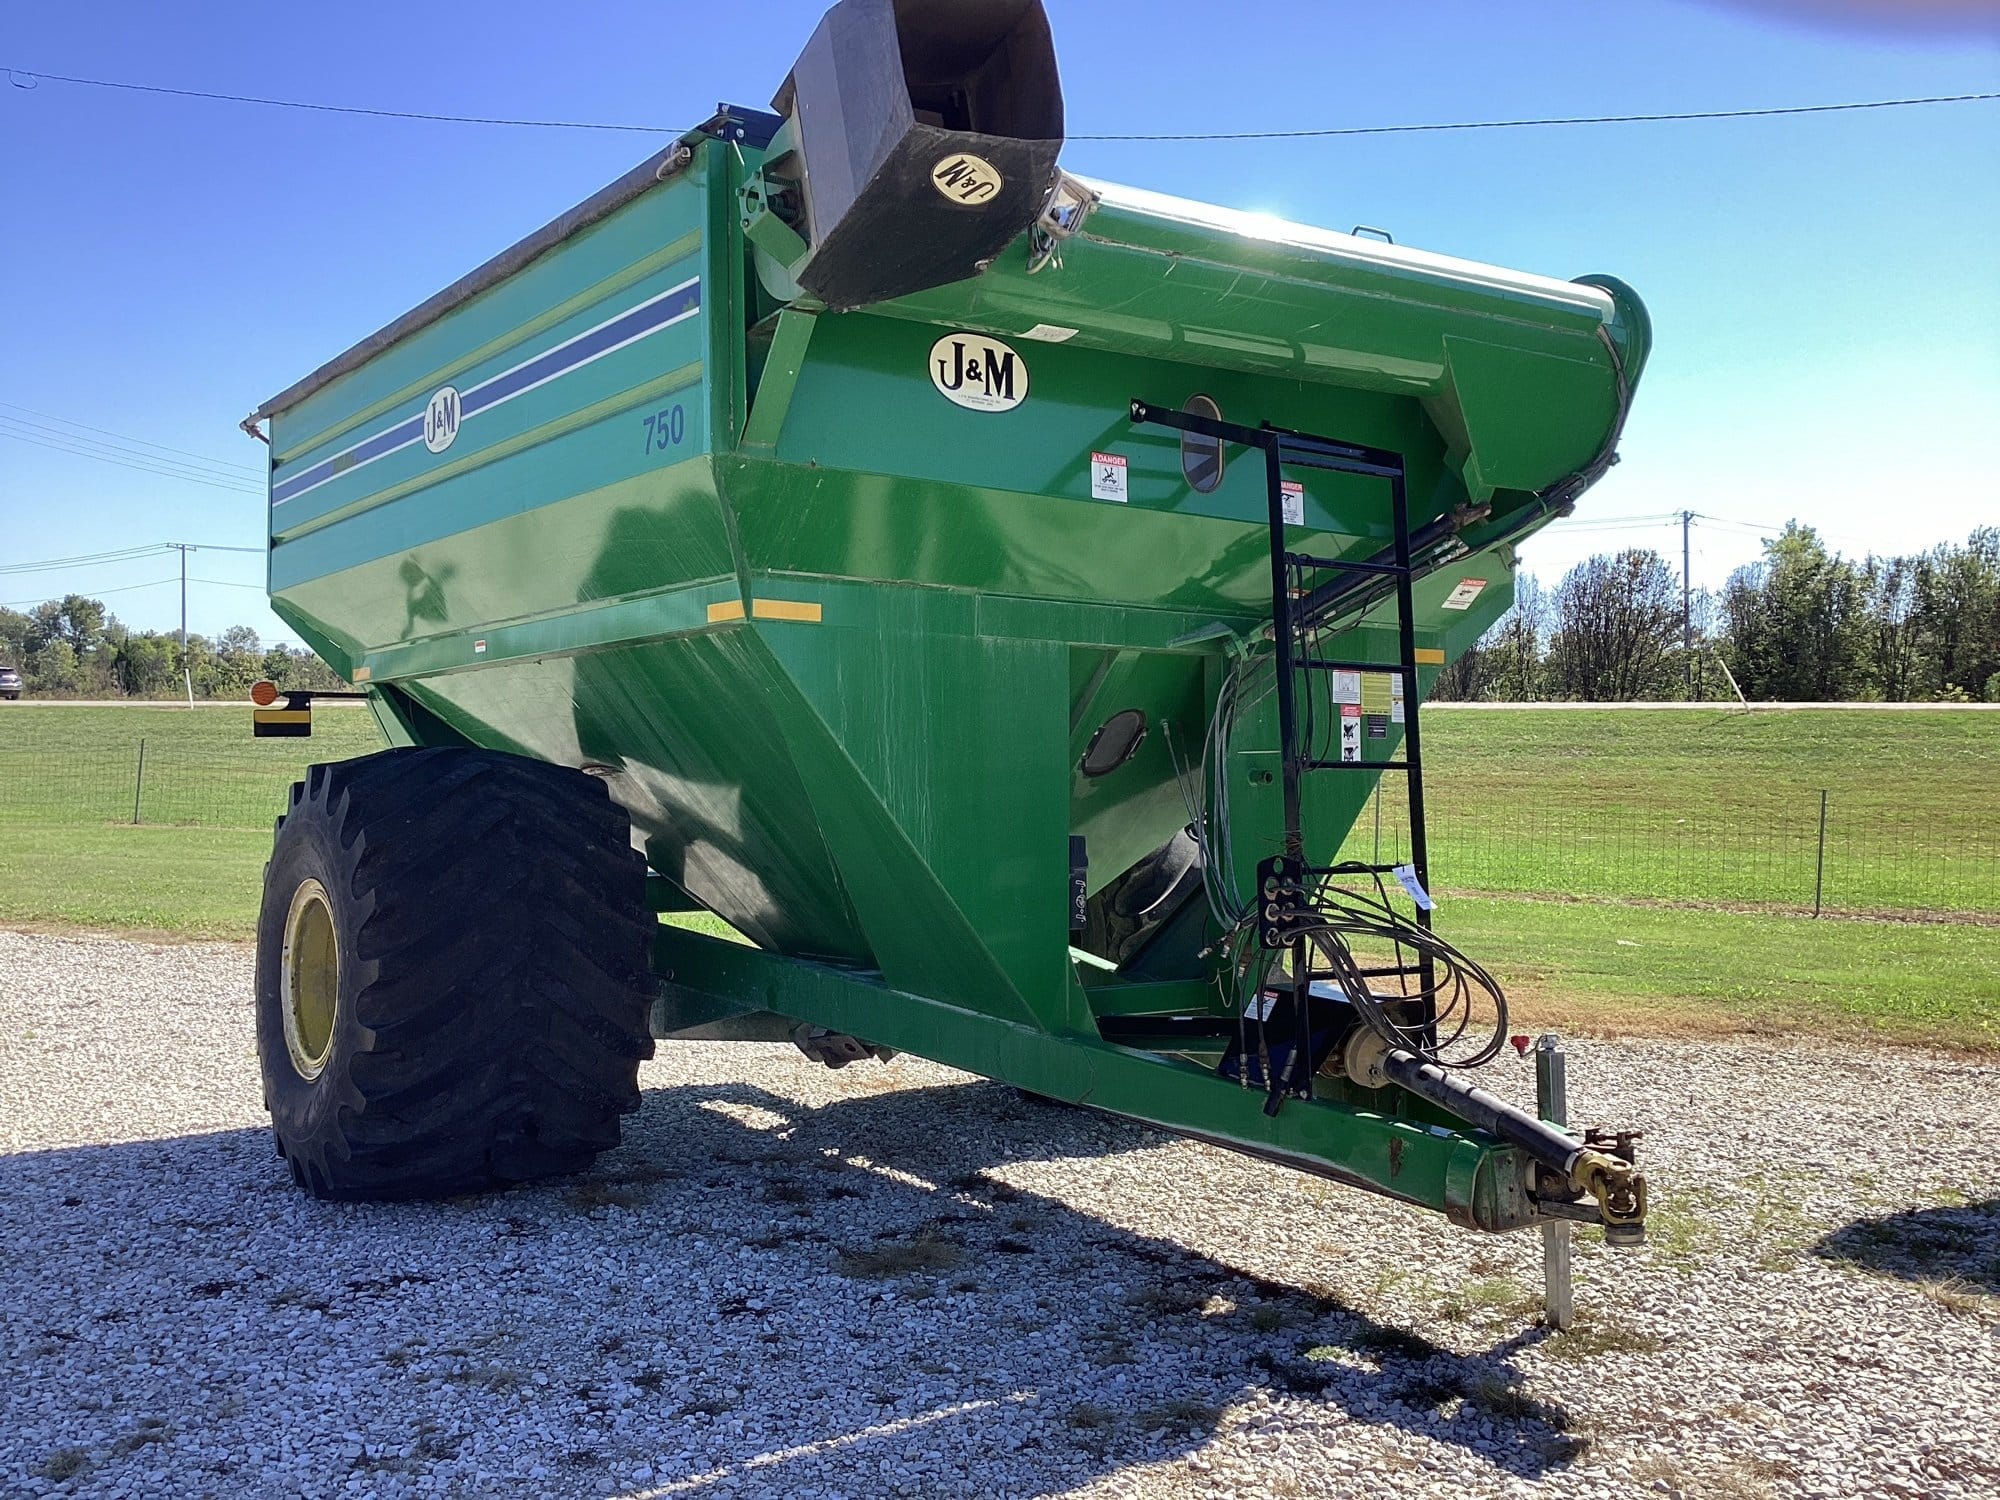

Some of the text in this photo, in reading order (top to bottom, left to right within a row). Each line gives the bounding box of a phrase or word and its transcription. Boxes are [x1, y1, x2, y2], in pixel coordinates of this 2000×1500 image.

[935, 158, 994, 199] J&M
[938, 341, 1016, 400] J&M
[426, 392, 456, 443] J&M
[643, 404, 684, 455] 750
[1098, 453, 1127, 466] DANGER
[1281, 481, 1303, 492] ANGER
